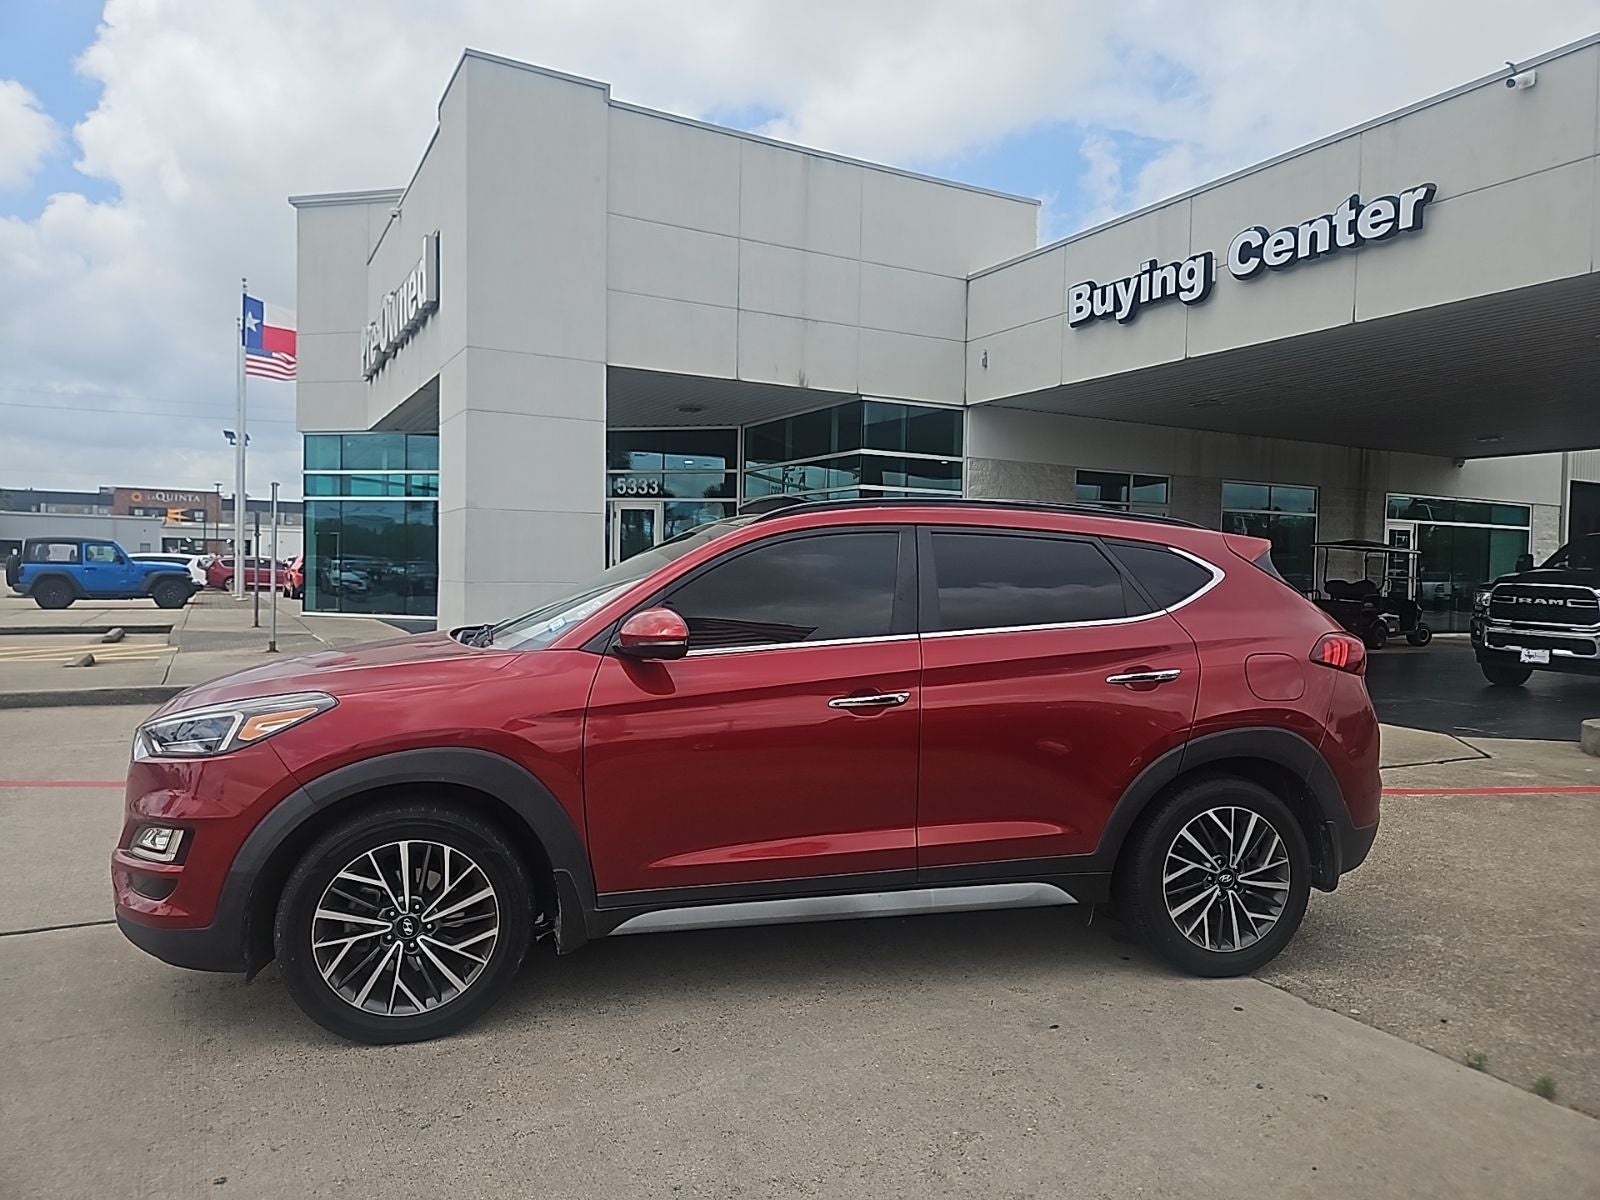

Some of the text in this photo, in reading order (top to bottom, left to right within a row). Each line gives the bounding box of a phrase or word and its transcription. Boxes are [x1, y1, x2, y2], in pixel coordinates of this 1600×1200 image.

[1068, 183, 1434, 327] Buying Center
[617, 477, 659, 495] 5333
[155, 492, 200, 502] QUINTA
[1518, 597, 1564, 606] RAM
